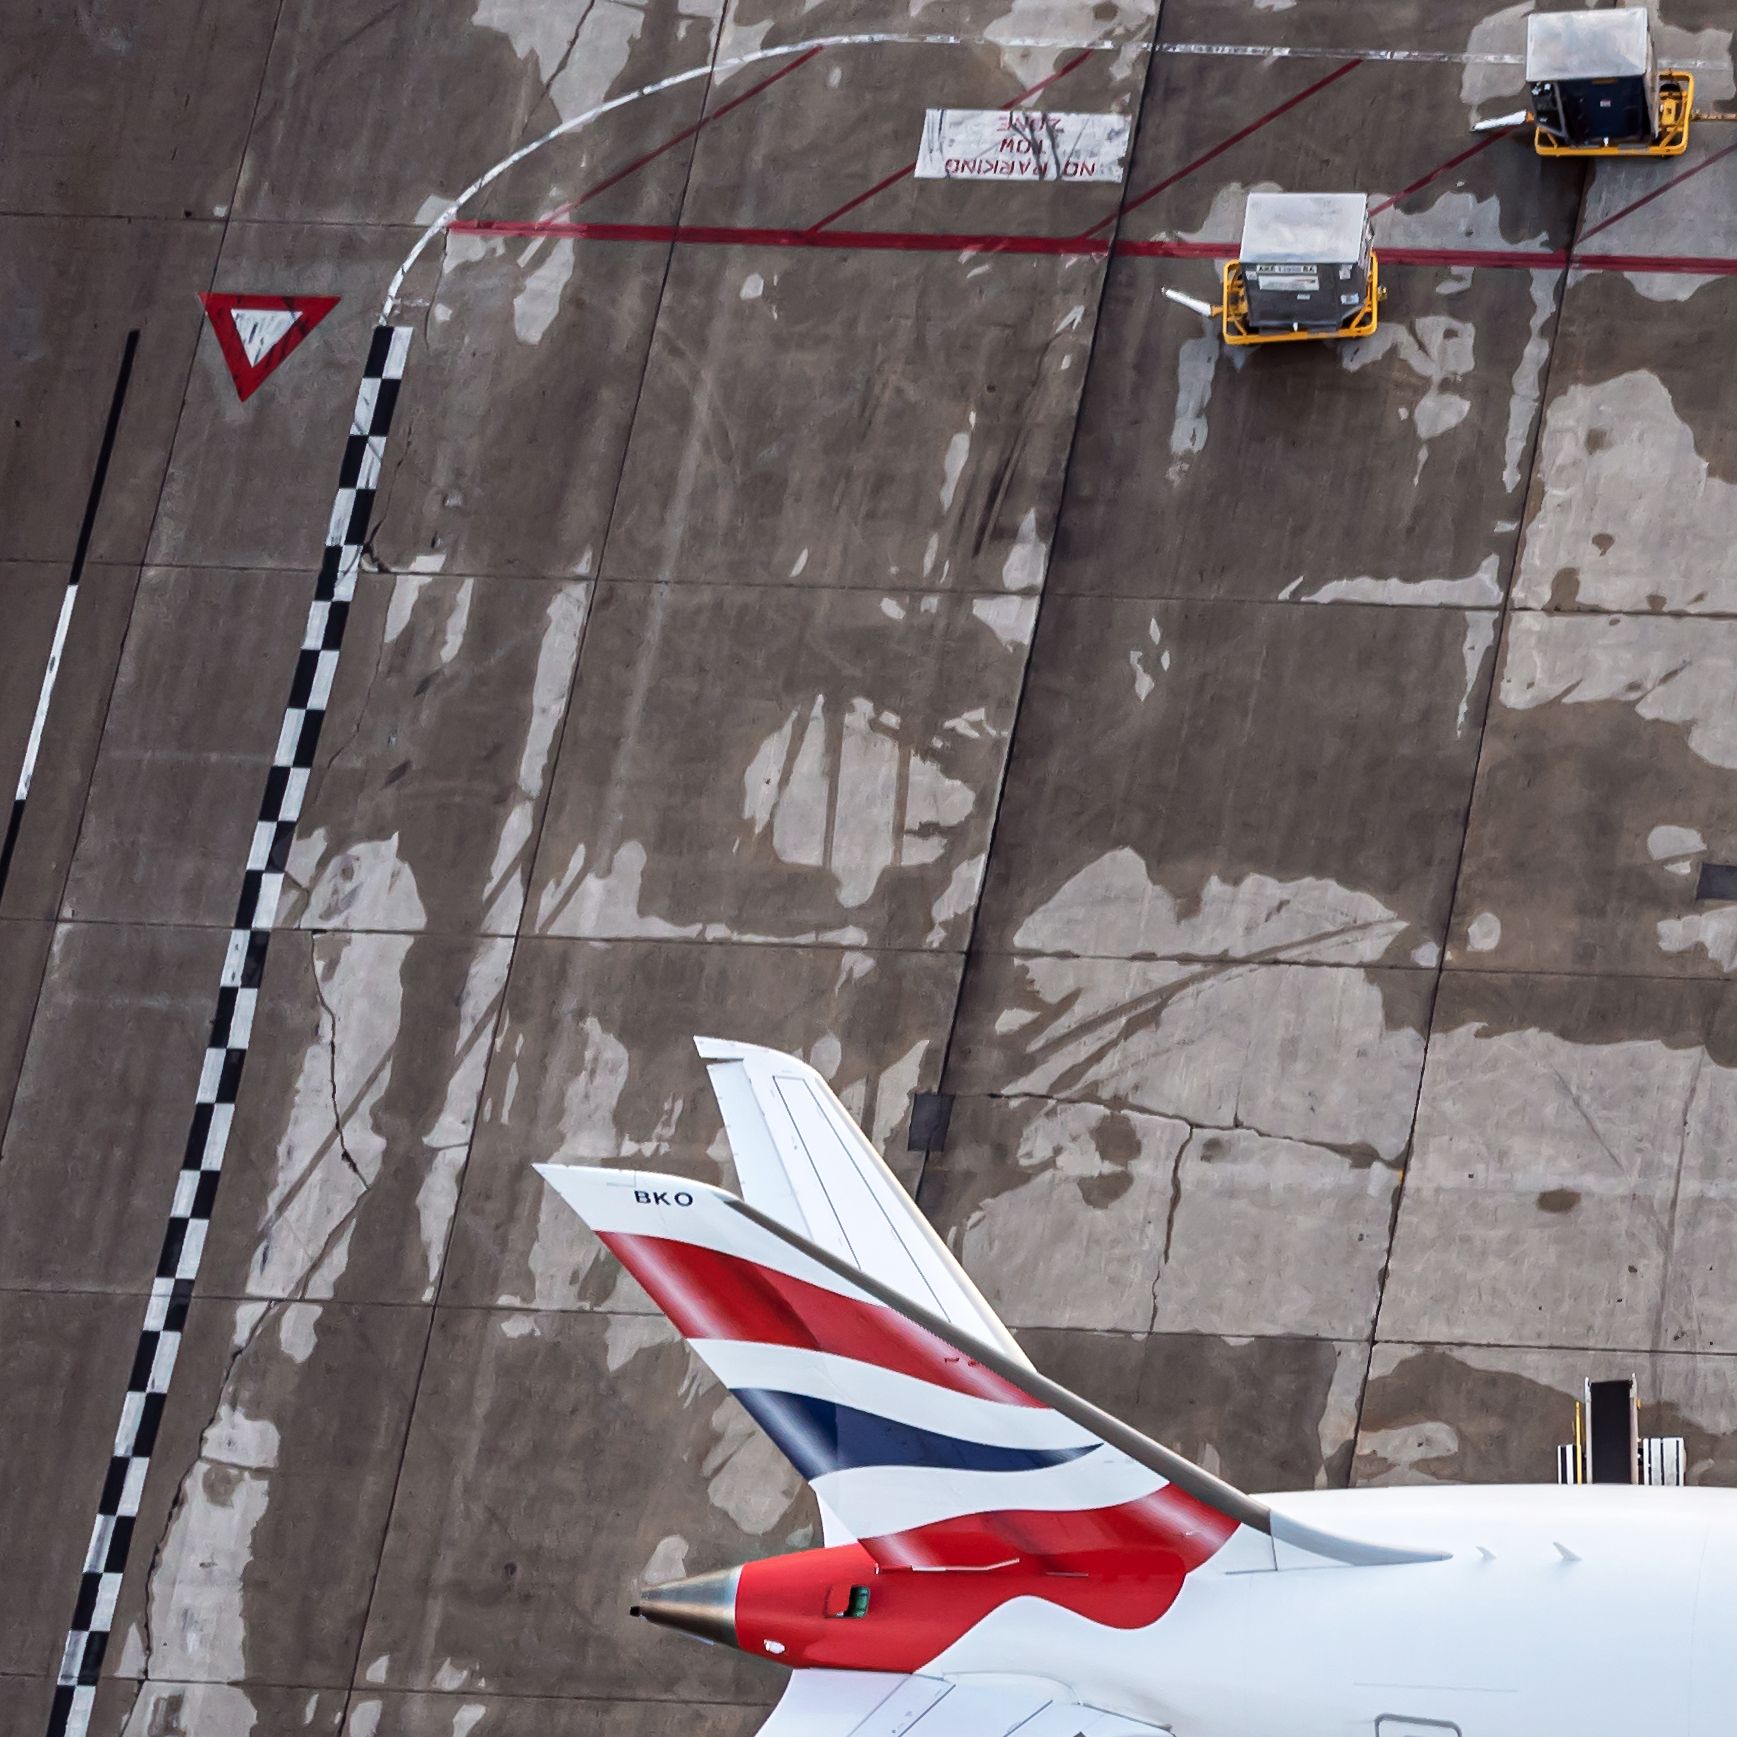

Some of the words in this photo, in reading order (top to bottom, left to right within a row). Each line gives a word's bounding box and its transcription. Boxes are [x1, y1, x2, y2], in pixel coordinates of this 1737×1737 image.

[999, 138, 1047, 154] TOW
[944, 158, 1048, 176] PARKING
[1062, 160, 1096, 177] NO
[634, 1190, 694, 1207] BKO
